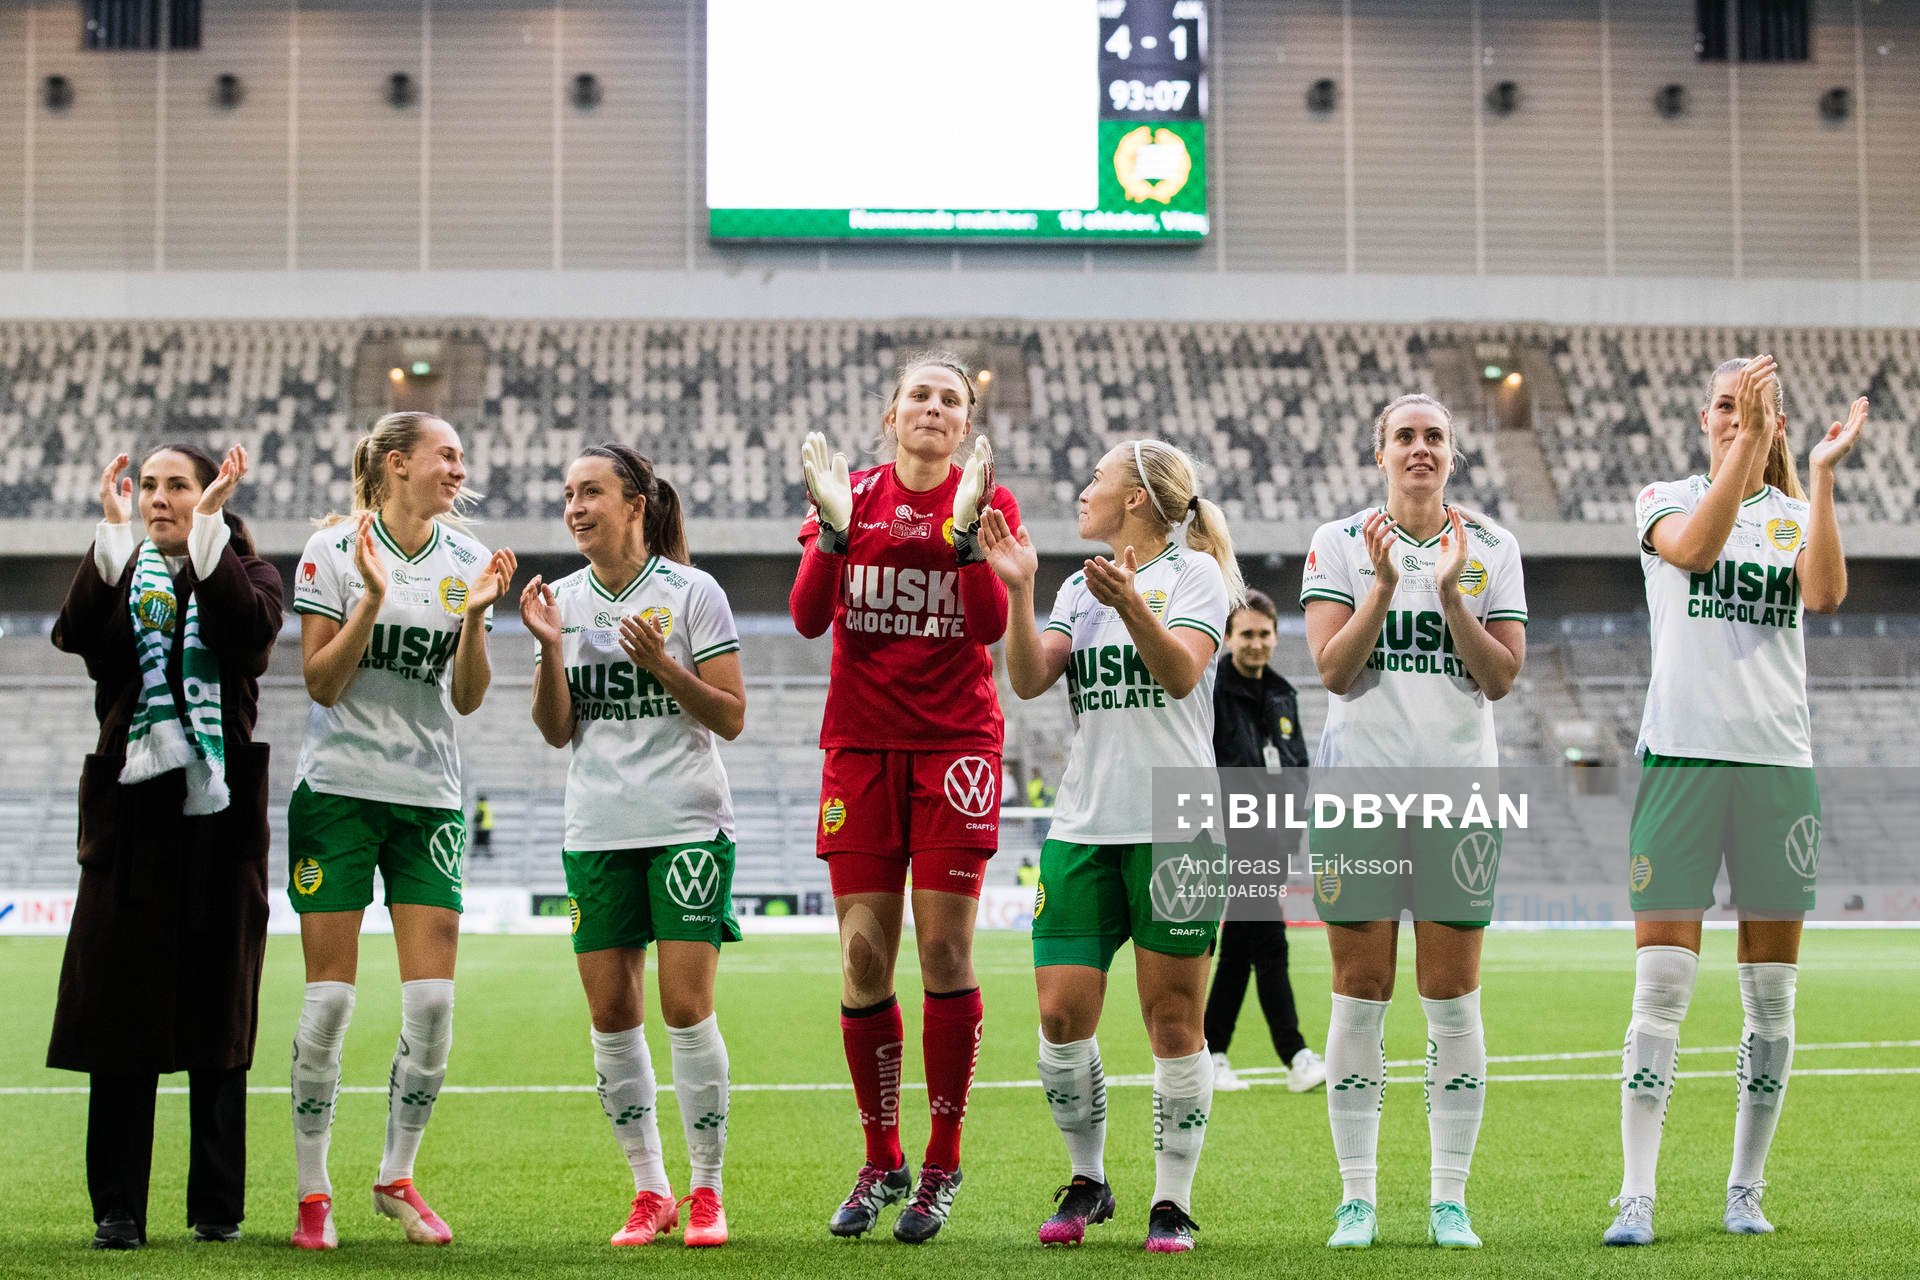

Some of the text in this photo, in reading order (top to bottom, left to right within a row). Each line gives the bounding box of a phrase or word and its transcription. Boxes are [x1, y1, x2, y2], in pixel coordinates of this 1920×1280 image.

[1105, 24, 1132, 60] 4
[1169, 25, 1187, 60] 1
[1109, 80, 1191, 111] 93:07
[846, 608, 964, 638] CHOCOLATE
[1688, 599, 1797, 629] CHOCOLATE
[574, 697, 680, 720] CHOCOLATE
[966, 823, 990, 831] CRAFT
[949, 869, 979, 880] CRAFT
[682, 914, 711, 922] CRAFT
[1169, 928, 1199, 937] CRAFT
